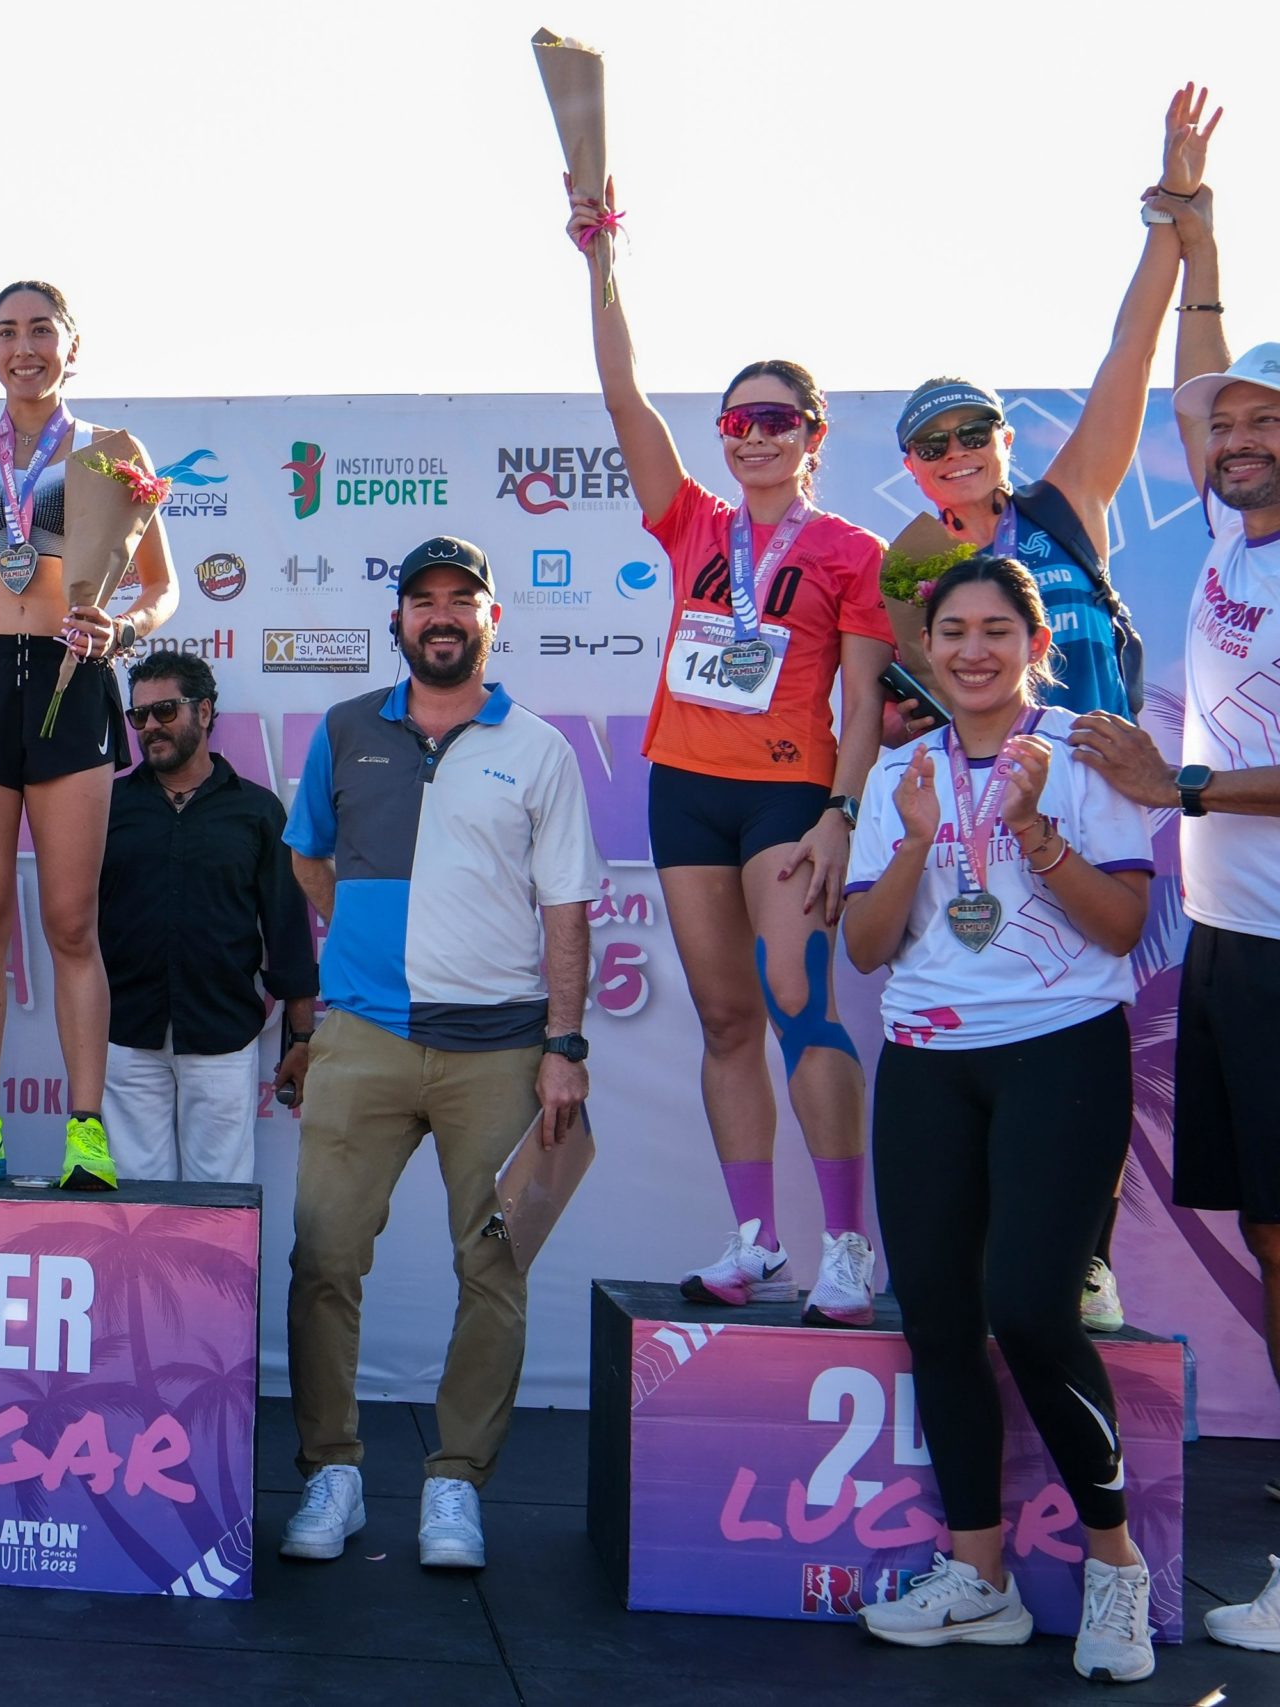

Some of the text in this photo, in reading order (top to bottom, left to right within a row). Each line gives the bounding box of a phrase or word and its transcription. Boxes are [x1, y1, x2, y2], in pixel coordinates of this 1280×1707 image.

[920, 402, 933, 413] IN
[932, 394, 961, 405] YOUR
[336, 457, 448, 475] INSTITUTO DEL
[498, 447, 627, 473] NUEVO
[337, 479, 448, 505] DEPORTE
[3, 570, 30, 578] FAMILIA
[194, 553, 244, 582] Nico's
[1035, 569, 1072, 587] IND
[513, 591, 592, 604] MEDIDENT
[296, 632, 365, 643] FUNDACIÓN
[540, 635, 644, 655] BYD
[1220, 639, 1248, 659] 2025
[300, 664, 328, 672] Wellness
[355, 665, 368, 673] Spa
[728, 666, 765, 676] FAMILIA
[493, 771, 516, 785] MAJA
[936, 838, 1014, 868] LA JER
[954, 923, 992, 932] FAMILIA
[721, 1467, 1084, 1563] LUGR
[41, 1559, 77, 1573] 2025
[806, 1567, 814, 1590] AMOR
